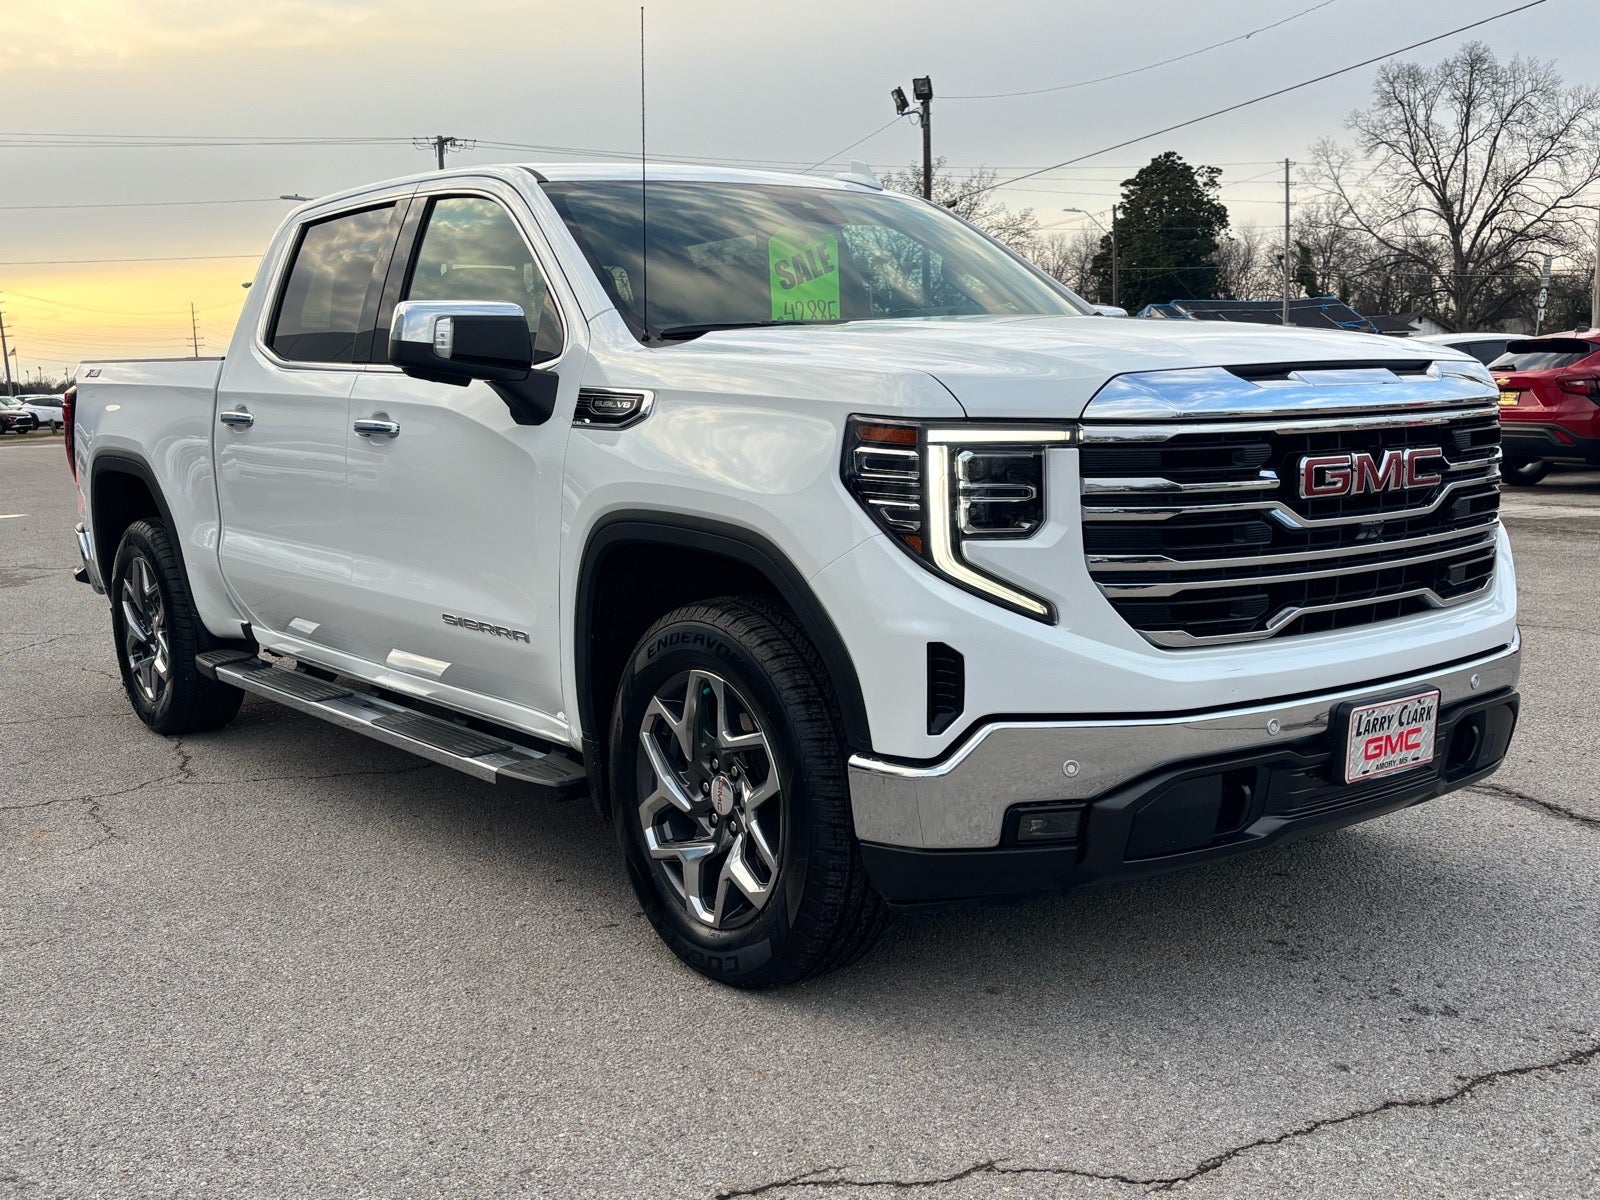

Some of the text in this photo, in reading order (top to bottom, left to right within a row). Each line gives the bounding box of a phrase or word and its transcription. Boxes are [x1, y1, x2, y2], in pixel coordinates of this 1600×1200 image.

[774, 242, 834, 290] SALE
[1299, 447, 1442, 499] GMC
[442, 613, 531, 644] SIERRA
[1356, 705, 1433, 737] LARRY CLARK
[1364, 727, 1422, 761] GMC
